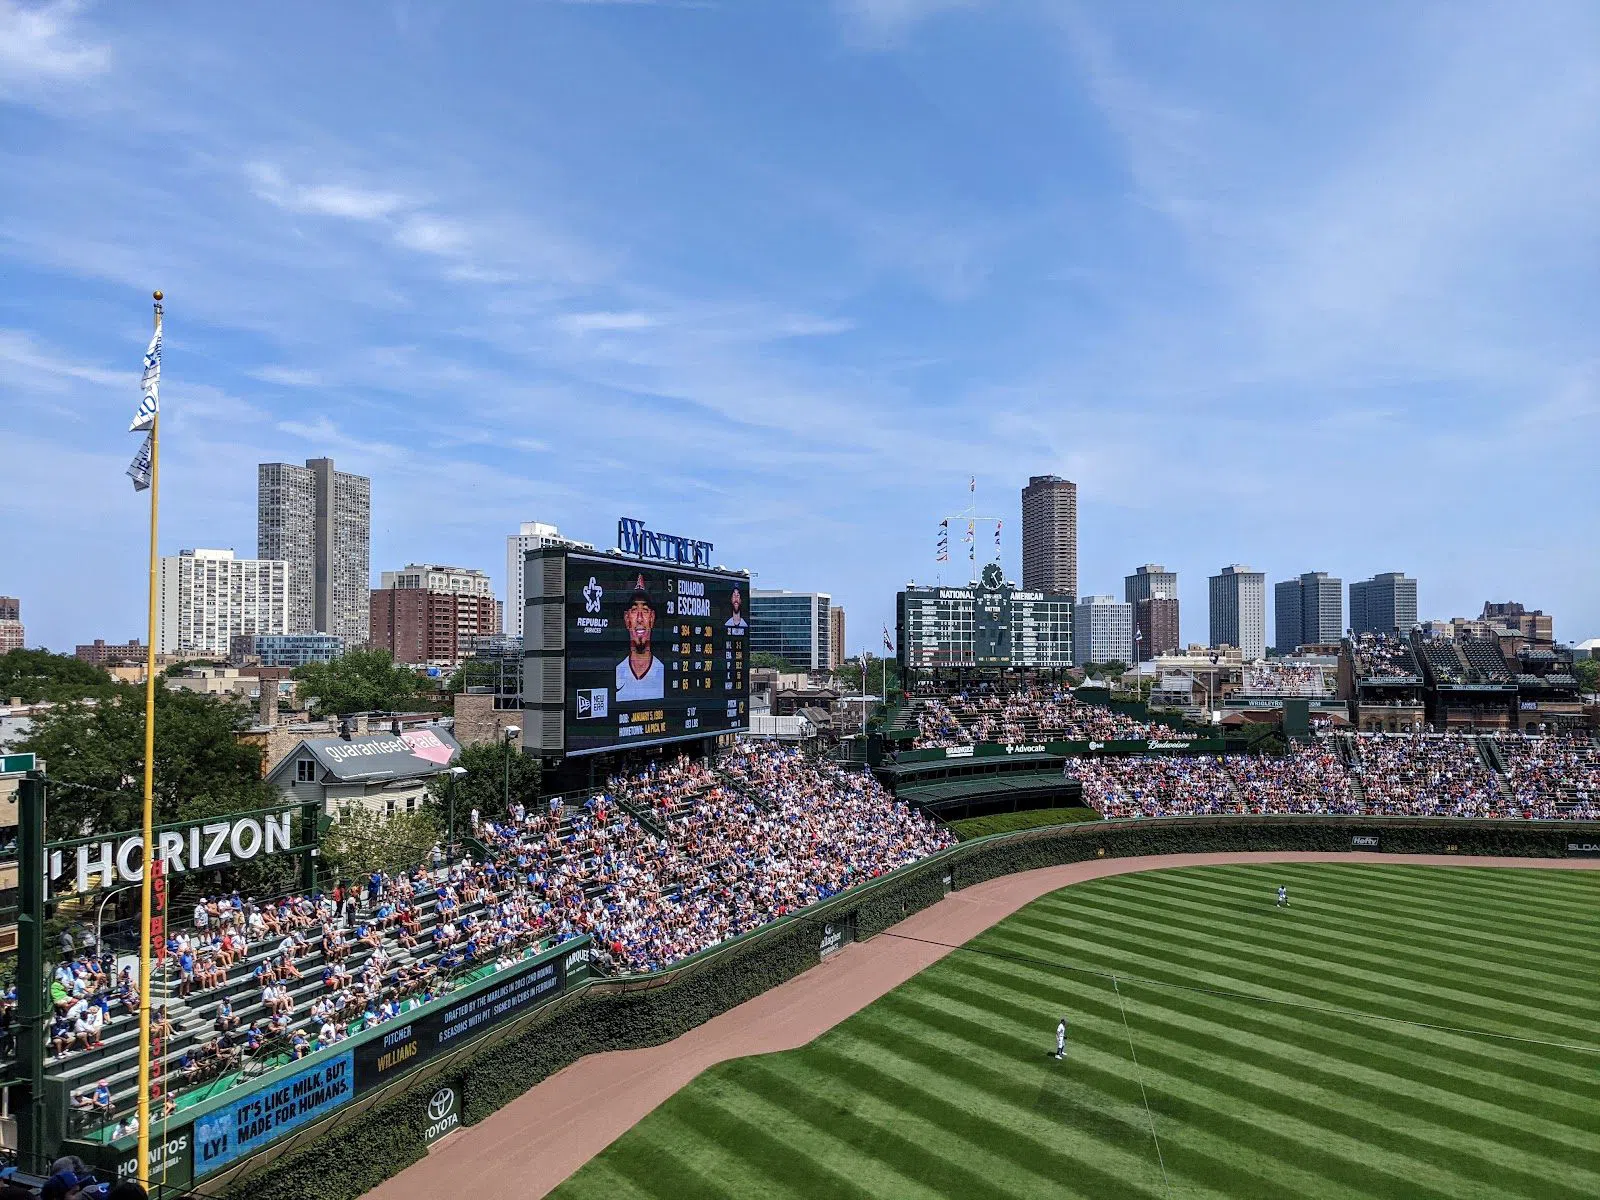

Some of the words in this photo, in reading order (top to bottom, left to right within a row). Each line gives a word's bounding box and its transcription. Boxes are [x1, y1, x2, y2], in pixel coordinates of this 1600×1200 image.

[620, 517, 714, 567] WINTRUST
[667, 579, 673, 592] 5
[677, 579, 705, 597] EDUARDO
[939, 590, 975, 599] NATIONAL
[1010, 592, 1044, 600] AMERICAN
[677, 596, 711, 616] ESCOBAR
[993, 612, 999, 621] 5
[577, 617, 608, 627] REPUBLIC
[593, 695, 605, 703] NEW
[593, 703, 605, 711] ERA
[691, 718, 699, 728] LBS
[945, 745, 975, 754] GRAINGER
[1014, 745, 1046, 754] Advocate
[1147, 740, 1190, 750] Budweiser
[77, 811, 291, 893] HORIZON
[151, 859, 167, 911] Hey
[151, 916, 167, 968] Hey
[443, 1019, 468, 1040] SEASONS
[468, 1012, 482, 1028] WITH
[481, 1009, 491, 1021] PIT
[493, 998, 512, 1015] SIGNED
[529, 986, 536, 997] IN
[535, 975, 558, 995] FEBRUARY
[444, 1006, 468, 1024] DRAFTED
[468, 1001, 477, 1013] BY
[476, 996, 487, 1009] THE
[486, 984, 509, 1005] MARLINS
[508, 981, 515, 992] IN
[514, 977, 526, 991] 2013
[384, 1025, 412, 1048] PITCHER
[377, 1040, 417, 1072] WILLIAMS
[237, 1100, 262, 1125] IT'S
[264, 1086, 290, 1112] LIKE
[293, 1072, 324, 1099] MILK,
[325, 1060, 347, 1081] BUT
[237, 1112, 272, 1144] MADE
[275, 1102, 296, 1126] FOR
[298, 1078, 349, 1114] HUMANS.
[425, 1113, 458, 1141] TOYOTA
[118, 1135, 189, 1178] HONITOS
[203, 1134, 228, 1161] LY!
